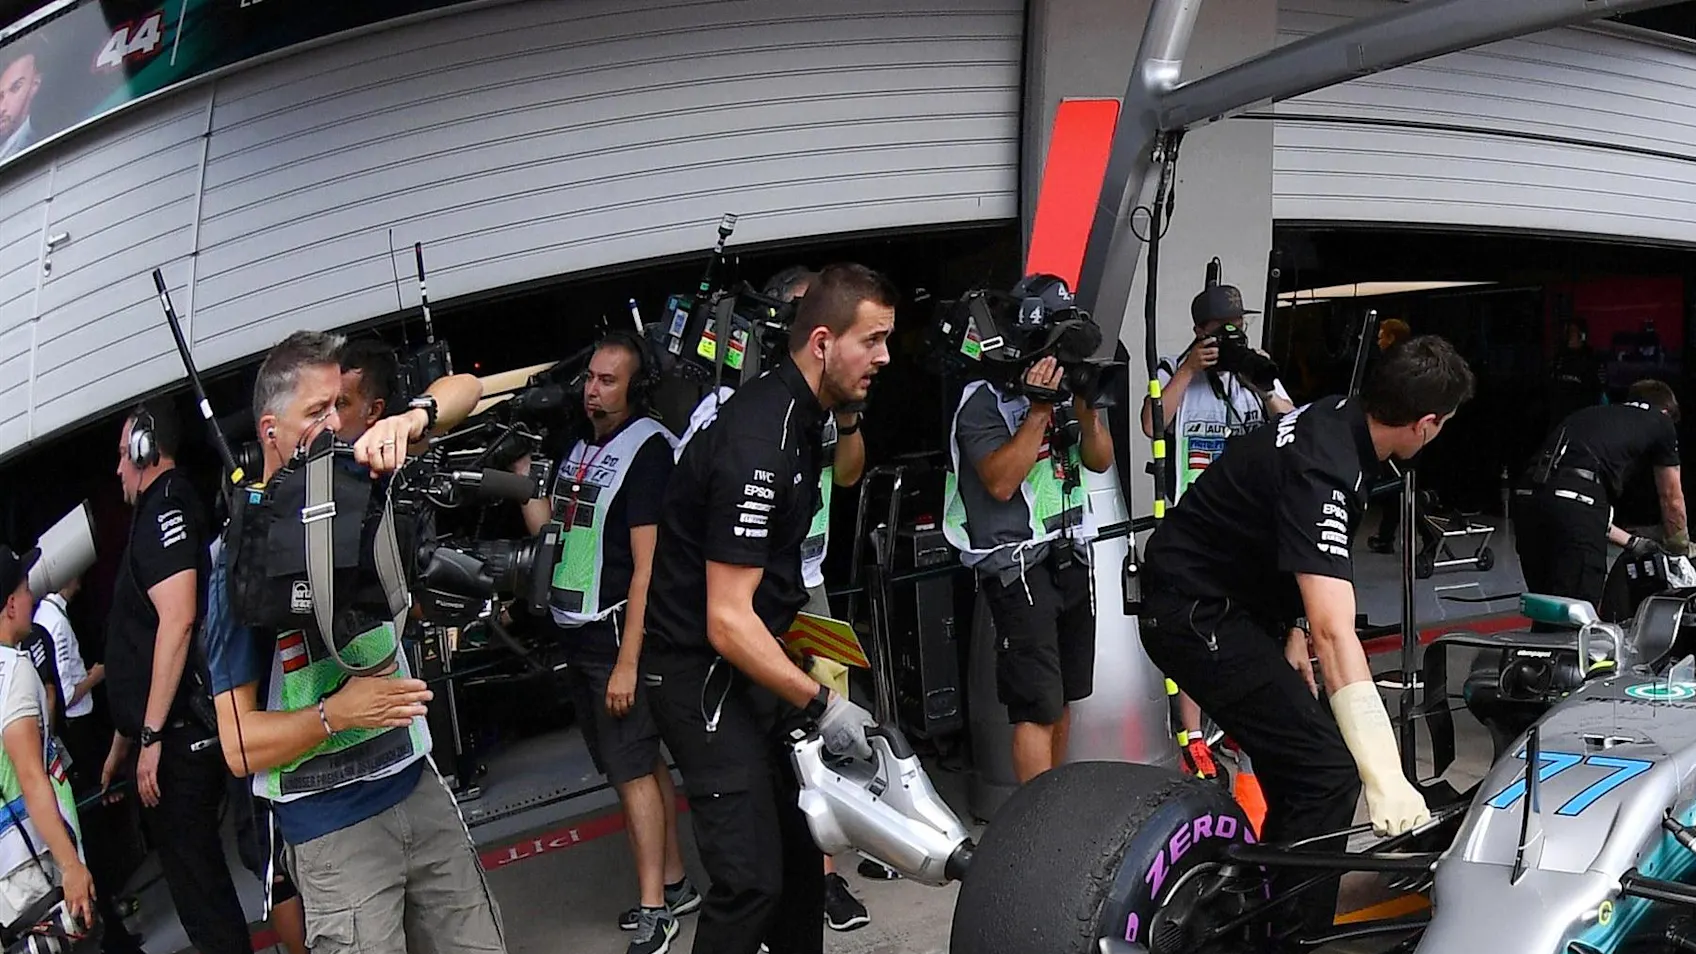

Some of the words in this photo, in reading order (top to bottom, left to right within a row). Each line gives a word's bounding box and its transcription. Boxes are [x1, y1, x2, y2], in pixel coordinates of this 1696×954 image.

[96, 14, 162, 68] 44
[744, 484, 775, 500] EPSON
[1485, 751, 1655, 817] 77
[1145, 814, 1237, 900] ZERO
